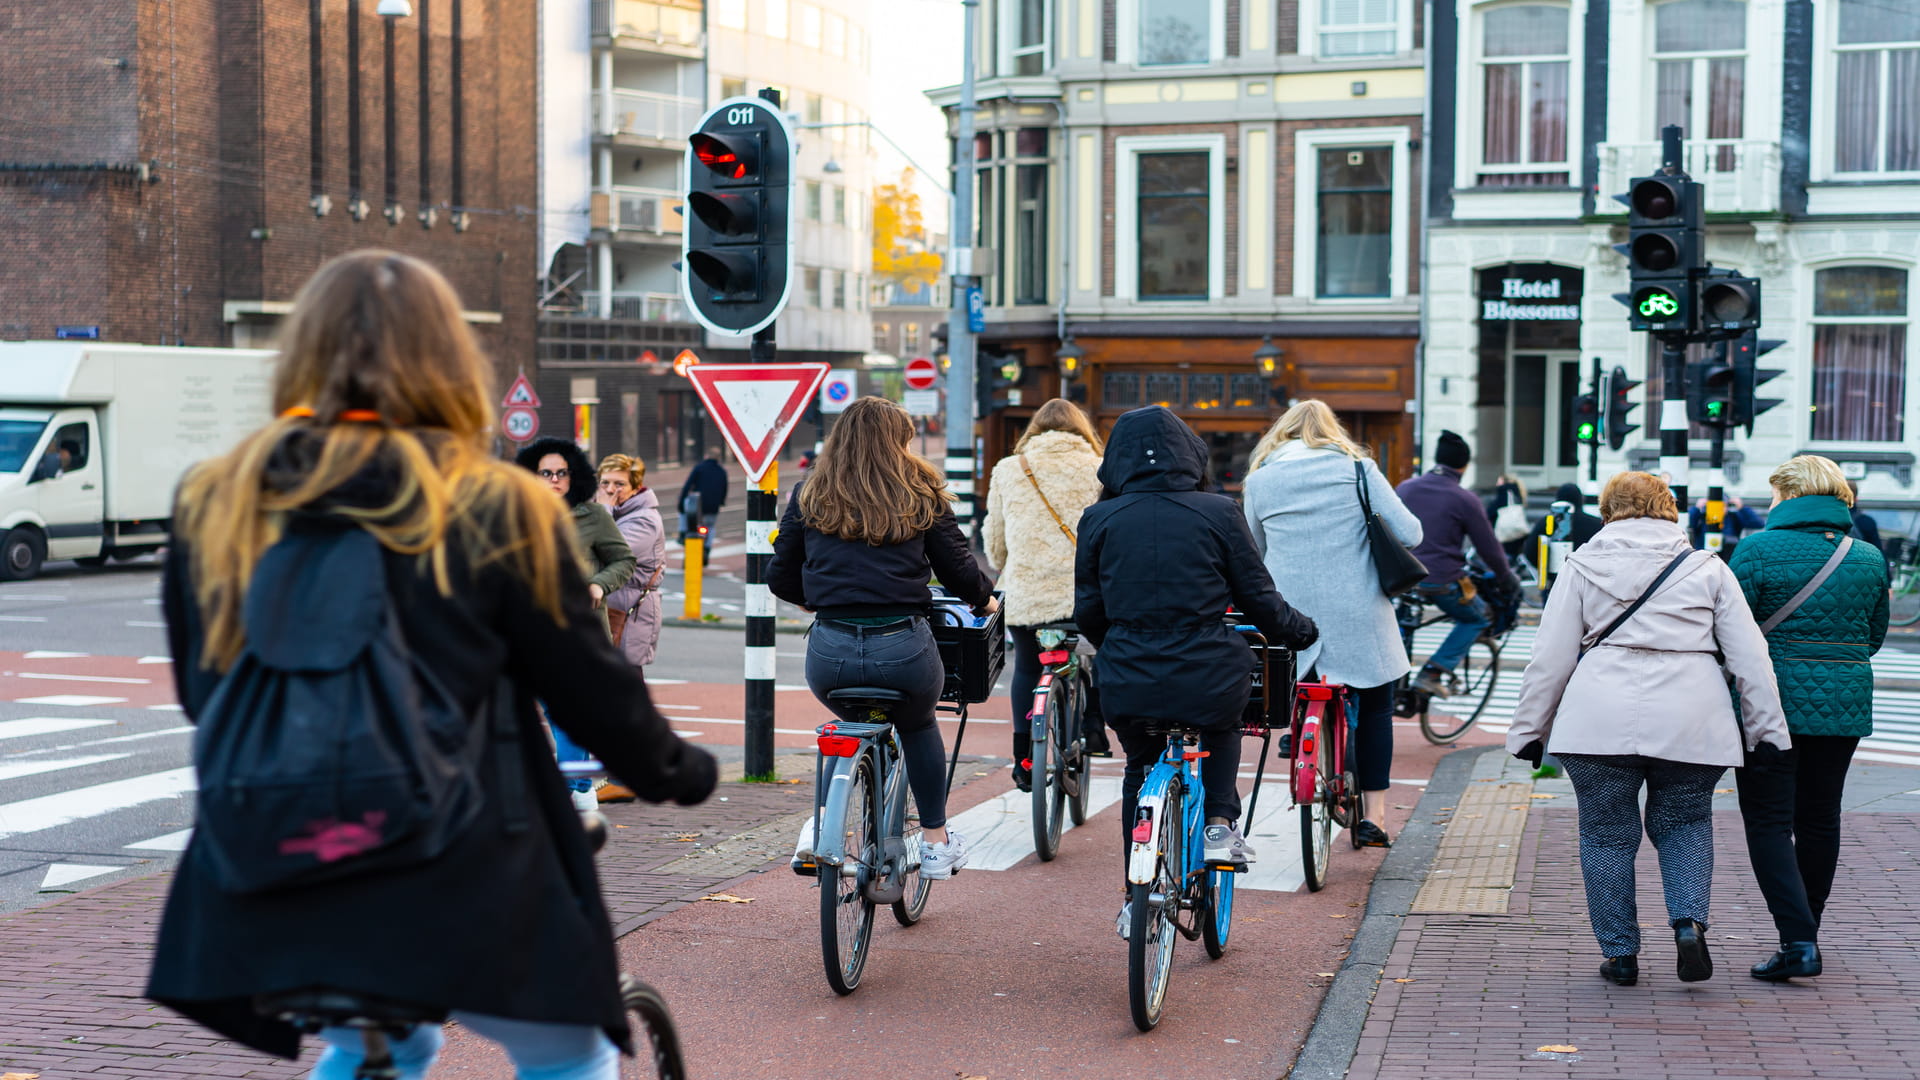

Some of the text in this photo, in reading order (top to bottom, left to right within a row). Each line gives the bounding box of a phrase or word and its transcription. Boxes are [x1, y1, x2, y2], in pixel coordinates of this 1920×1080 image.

[728, 107, 753, 125] 011
[1502, 279, 1560, 298] Hotel
[1483, 301, 1579, 320] Blossoms
[511, 417, 531, 430] 30
